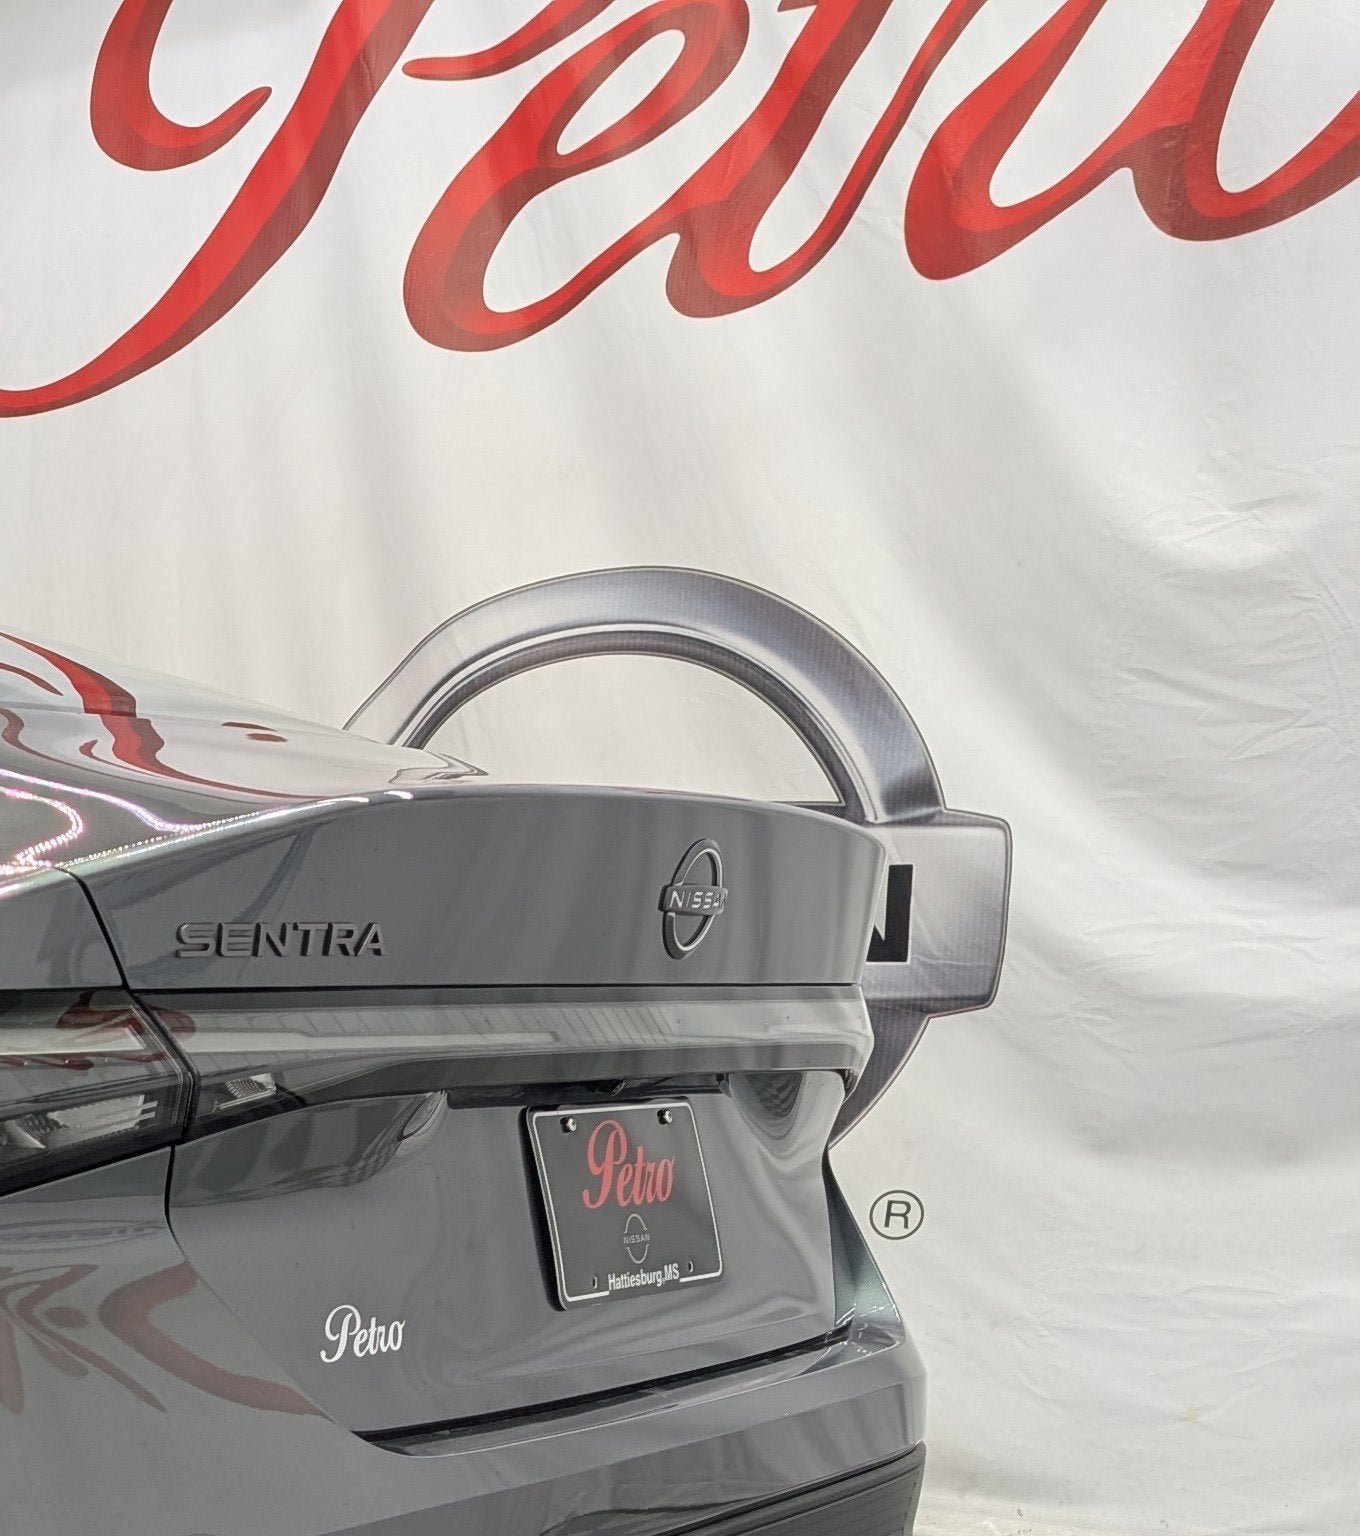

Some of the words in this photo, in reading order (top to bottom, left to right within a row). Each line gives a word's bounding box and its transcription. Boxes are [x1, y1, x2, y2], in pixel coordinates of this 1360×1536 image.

[174, 921, 387, 959] SENTRA
[582, 1118, 677, 1210] Petro
[622, 1232, 651, 1244] NISSAN
[320, 1304, 407, 1363] Petro
